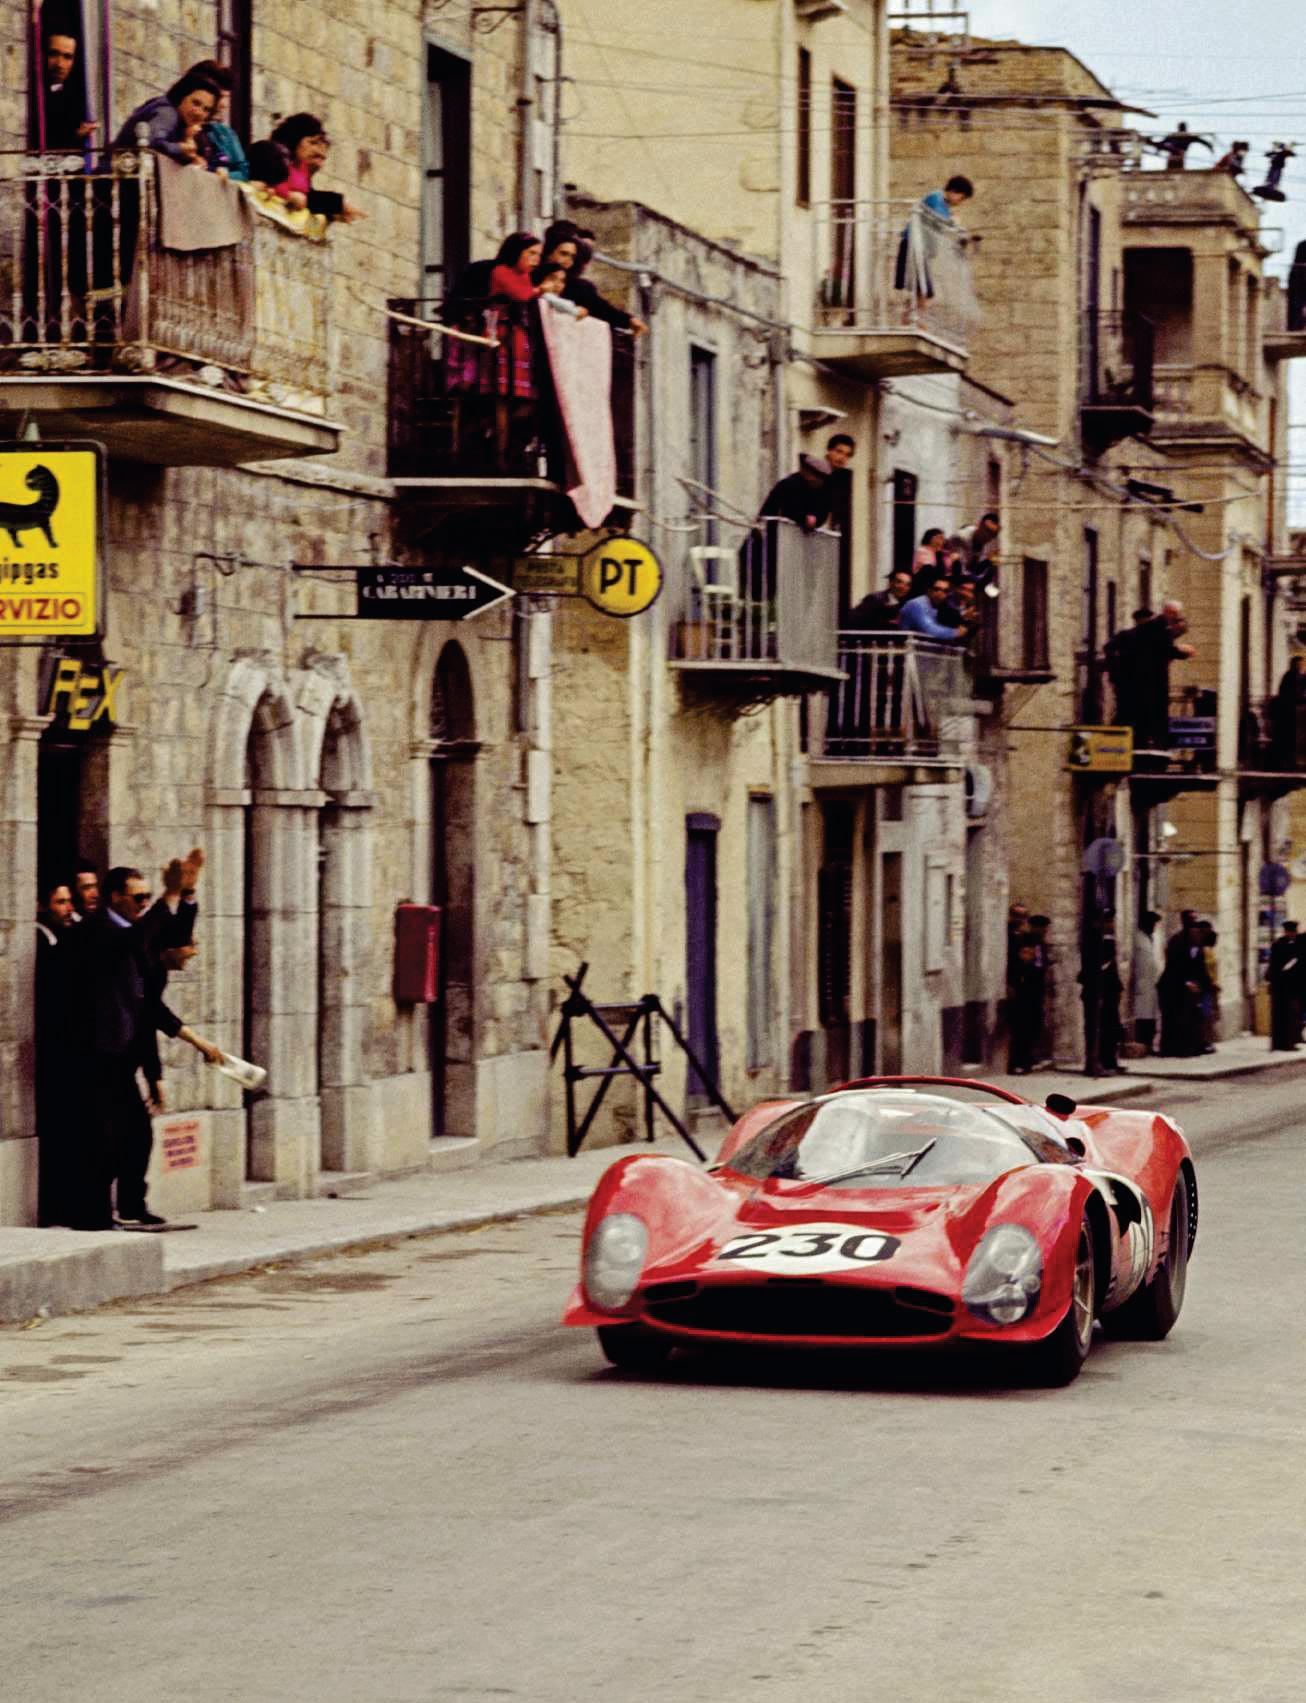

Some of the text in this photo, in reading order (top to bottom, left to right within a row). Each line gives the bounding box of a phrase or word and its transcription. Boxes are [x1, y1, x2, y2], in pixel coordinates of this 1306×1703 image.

[0, 557, 59, 585] ipgas
[600, 558, 643, 596] PT
[49, 659, 126, 731] REX
[717, 1232, 902, 1262] 230
